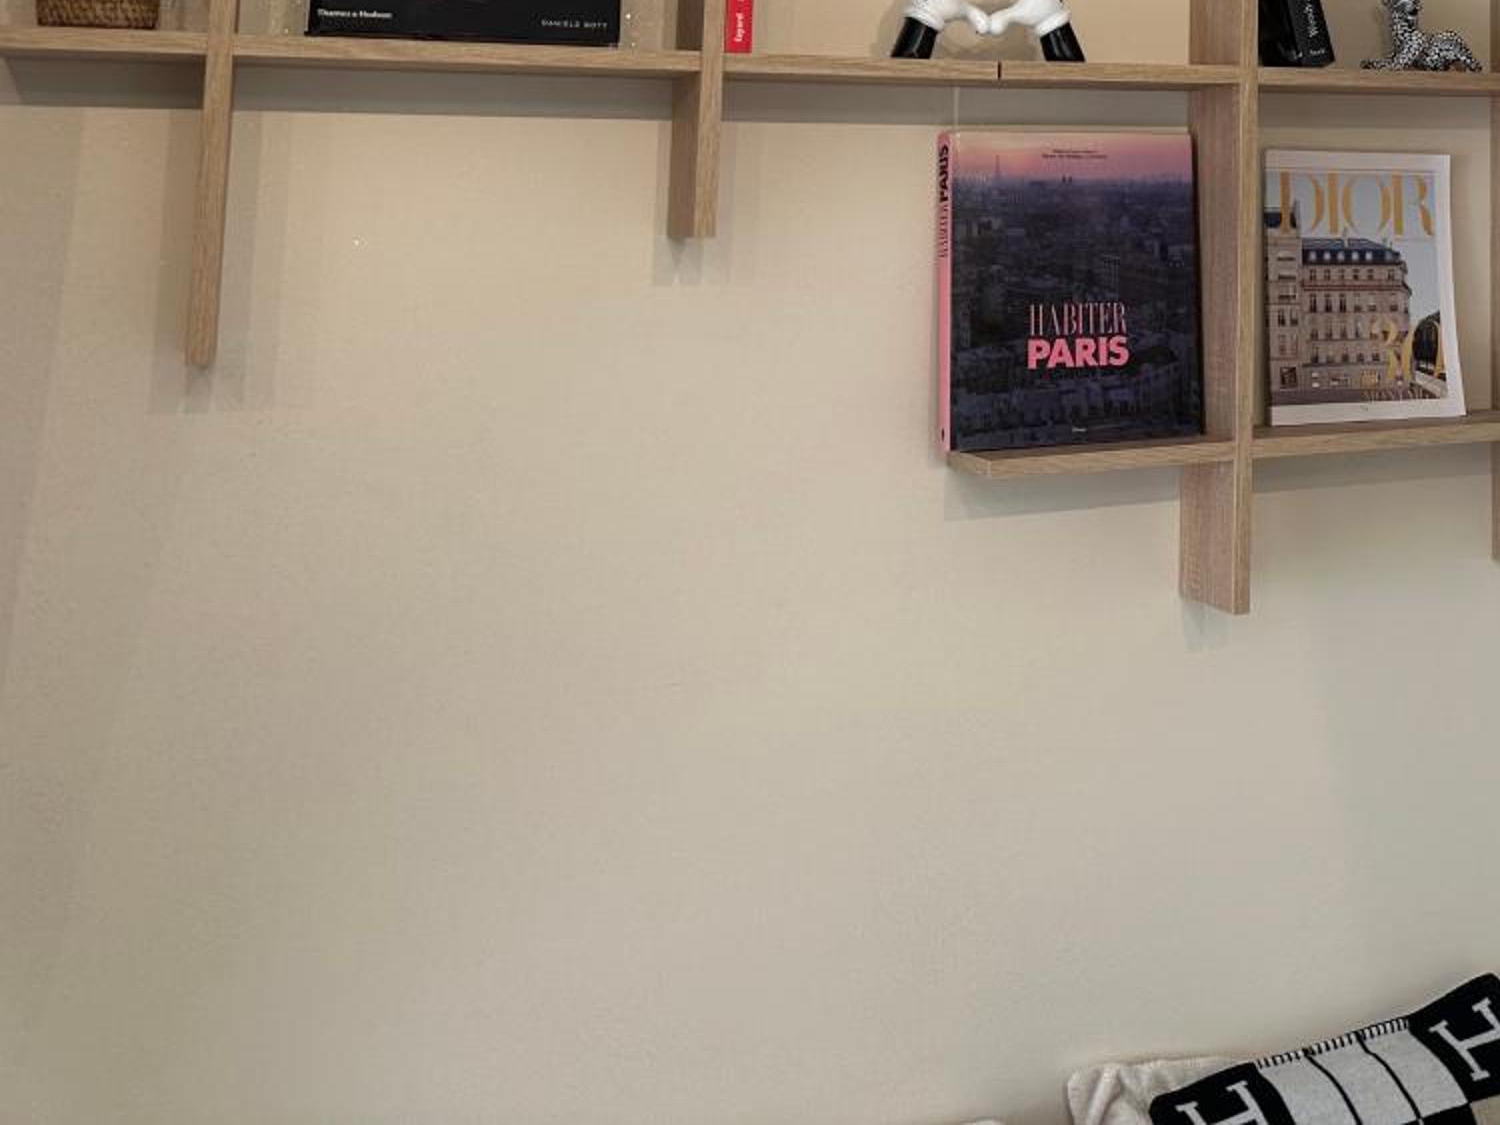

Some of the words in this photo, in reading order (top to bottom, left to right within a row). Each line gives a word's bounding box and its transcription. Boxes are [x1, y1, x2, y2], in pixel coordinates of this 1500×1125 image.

[938, 143, 949, 202] PARIS
[1276, 170, 1436, 236] DIOR
[1029, 301, 1127, 336] HABITER
[1027, 335, 1130, 369] PARIS
